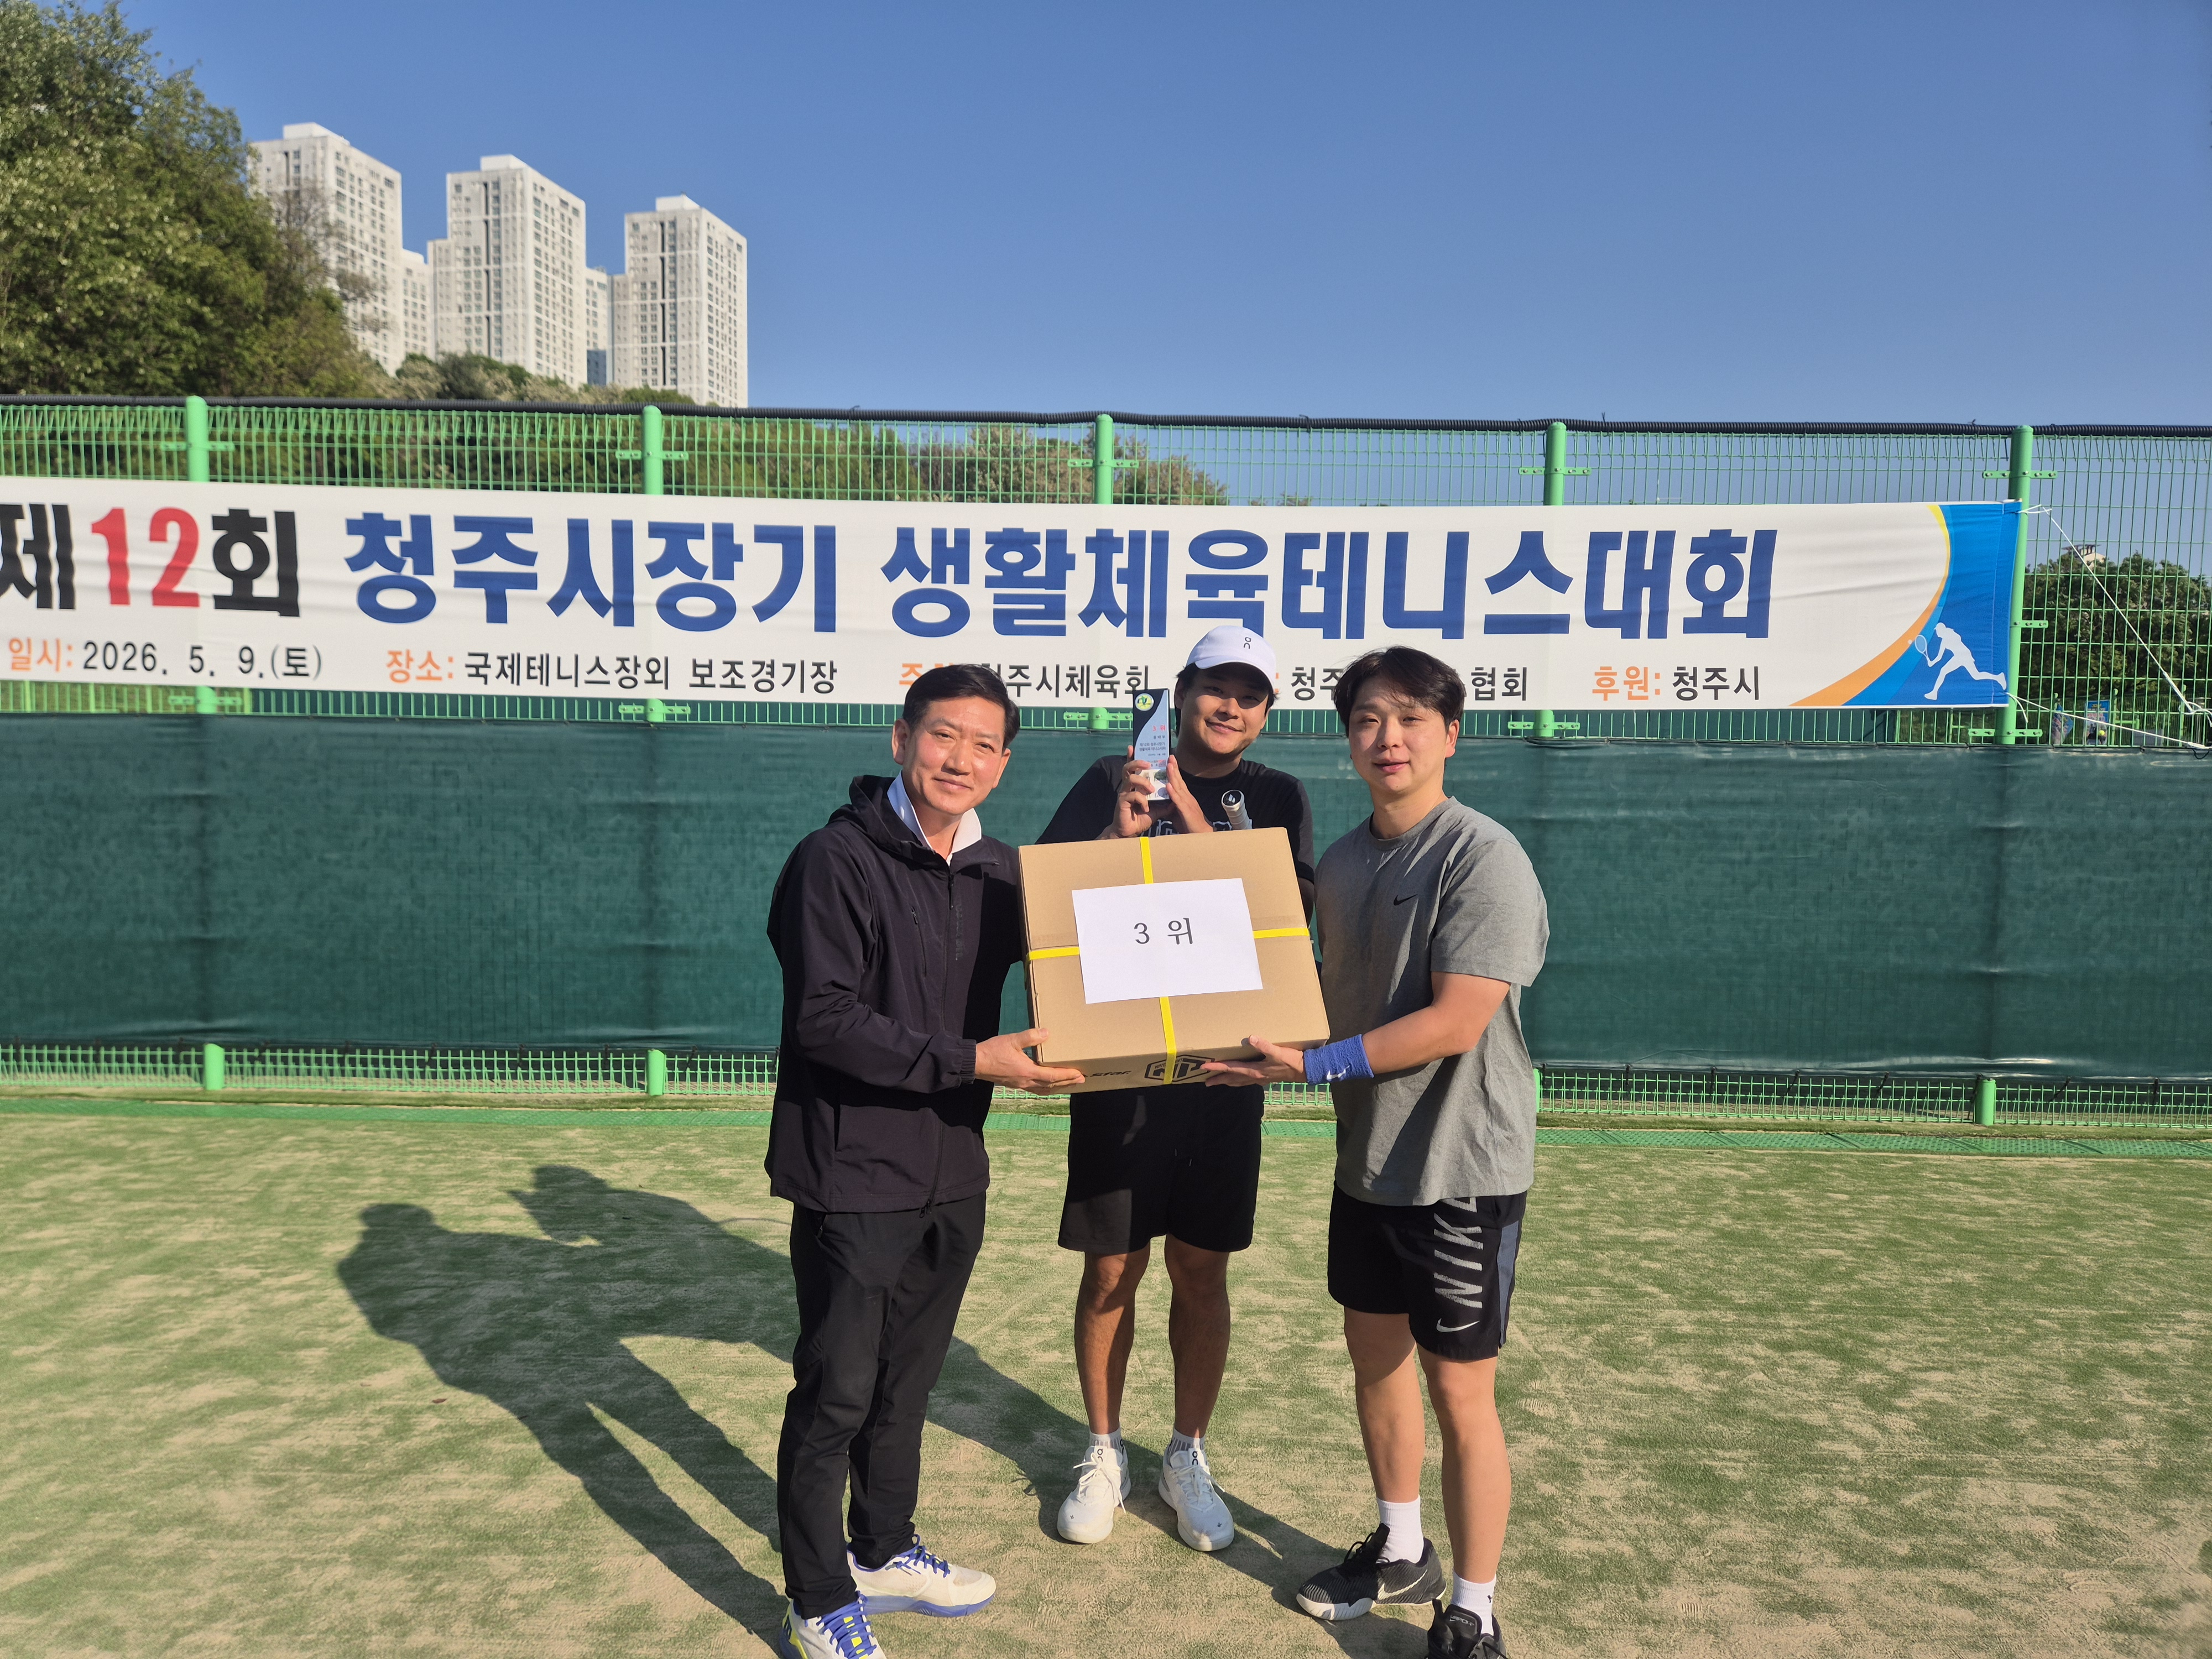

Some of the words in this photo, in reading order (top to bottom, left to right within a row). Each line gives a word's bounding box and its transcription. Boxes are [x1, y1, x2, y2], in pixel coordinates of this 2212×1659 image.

[0, 504, 300, 617] 제12회
[345, 512, 836, 632] 청주시장기
[881, 527, 1778, 639] 생활체육테니스대회
[8, 638, 74, 672] 일시:
[83, 641, 167, 675] 2026.
[190, 646, 215, 676] 5.
[238, 645, 322, 680] 9.(토)
[387, 649, 454, 685] 장소:
[465, 653, 669, 690] 국제테니스장외
[689, 659, 837, 694] 보조경기장
[1592, 666, 1661, 701] 후원:
[1672, 666, 1760, 701] 청주시
[1134, 922, 1150, 945] 3
[1167, 917, 1193, 945] 위
